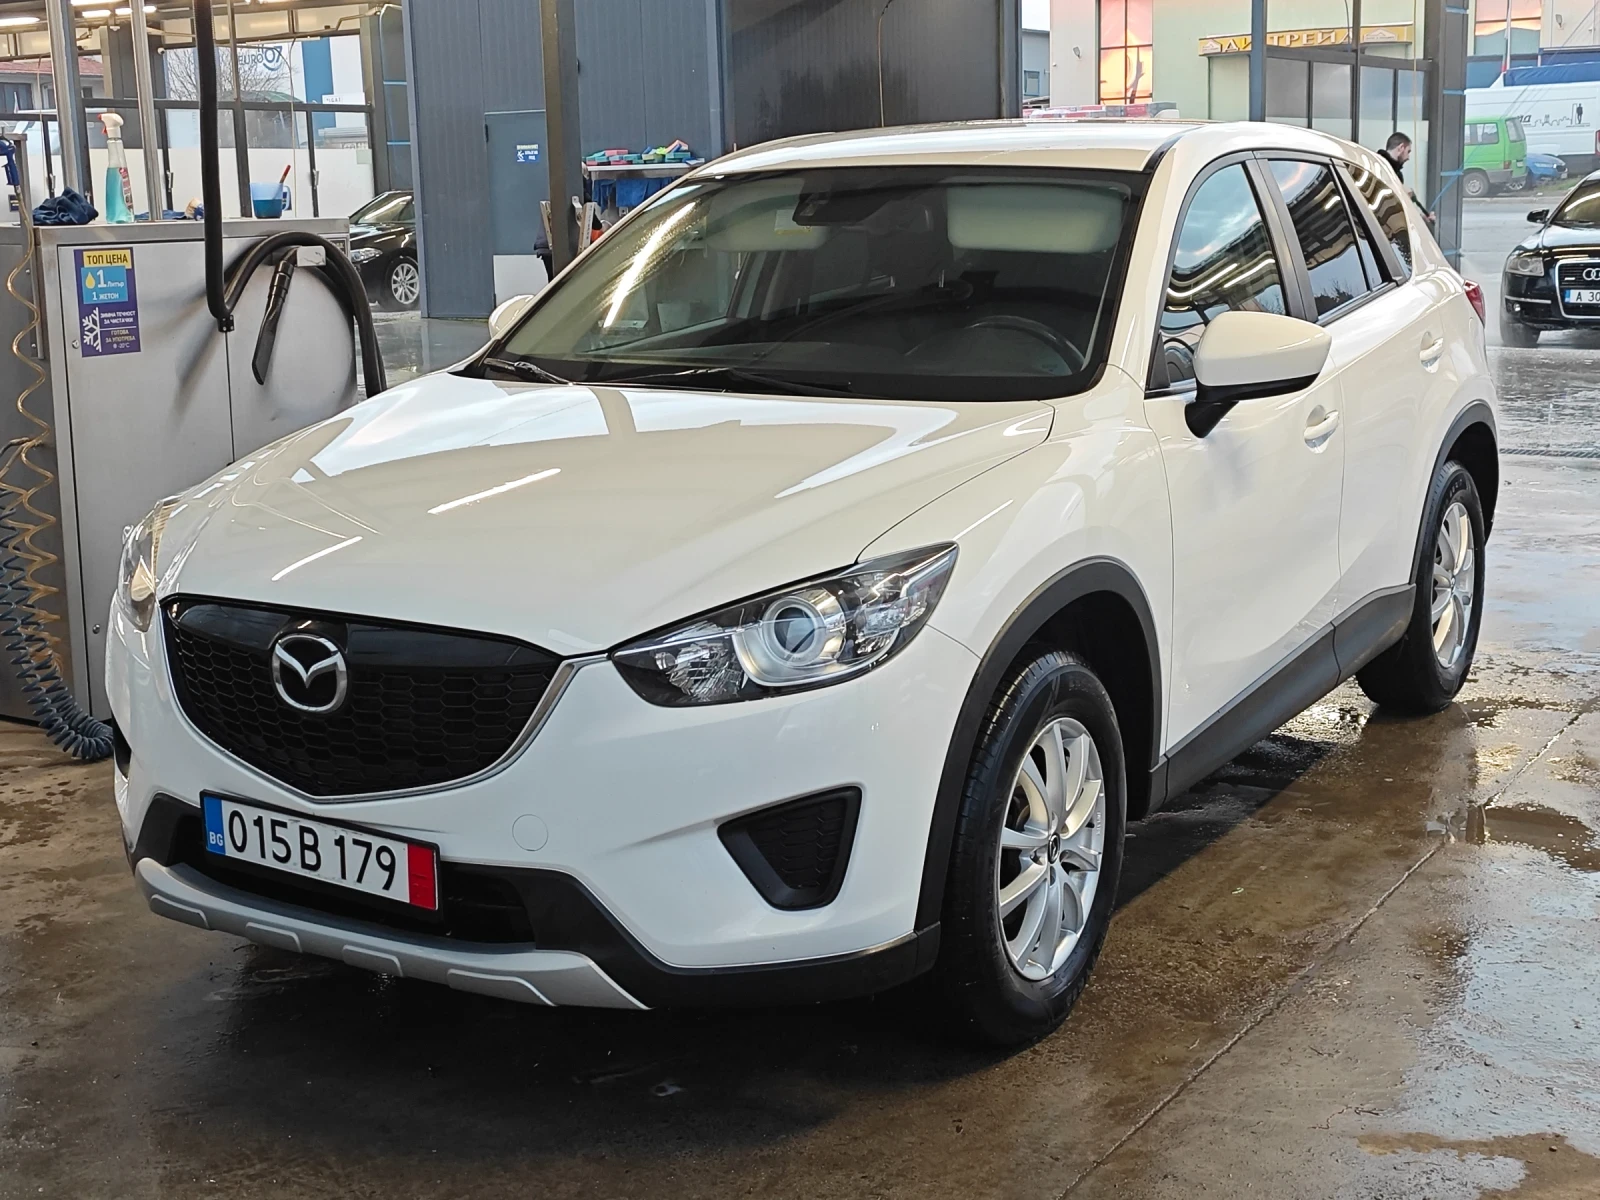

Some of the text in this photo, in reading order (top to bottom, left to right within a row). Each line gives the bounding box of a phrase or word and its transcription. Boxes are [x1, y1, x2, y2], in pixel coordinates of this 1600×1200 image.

[87, 253, 128, 265] ТОП ЦЕНА
[97, 269, 107, 288] 1
[92, 292, 98, 300] 1
[209, 832, 224, 846] BG
